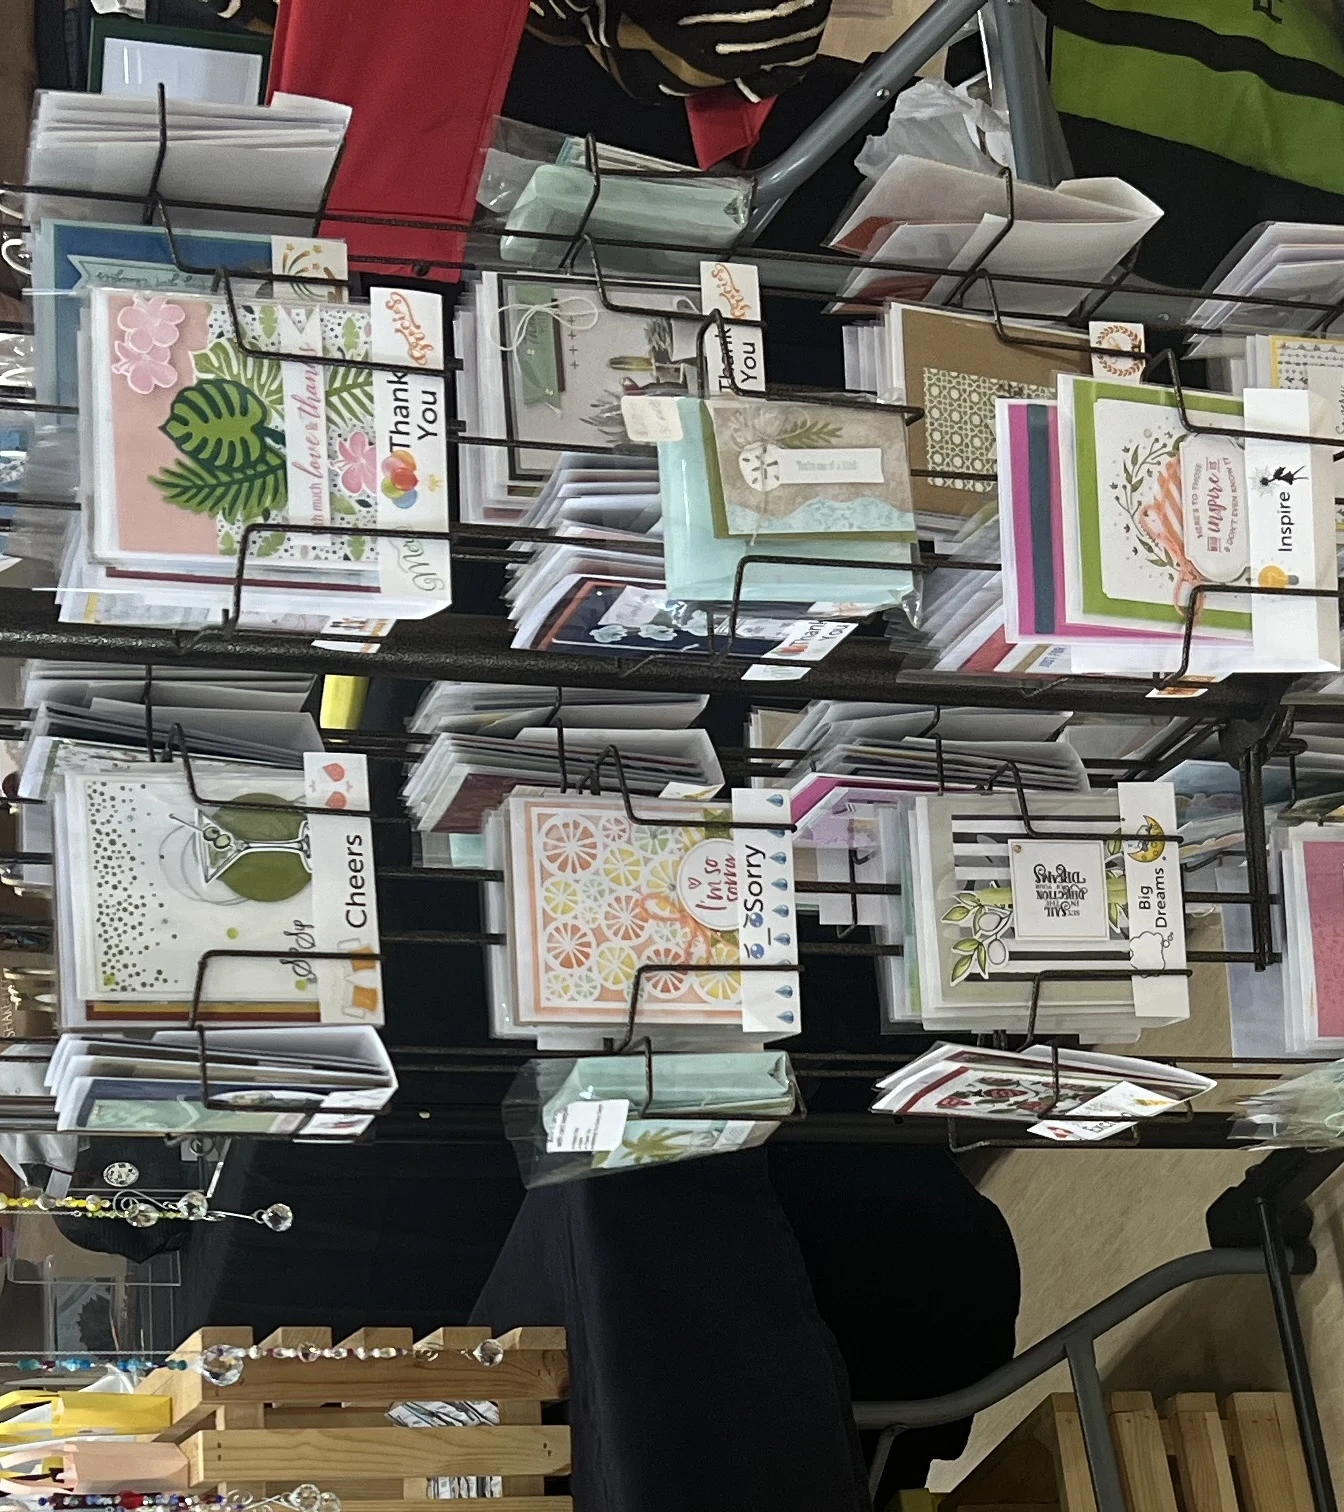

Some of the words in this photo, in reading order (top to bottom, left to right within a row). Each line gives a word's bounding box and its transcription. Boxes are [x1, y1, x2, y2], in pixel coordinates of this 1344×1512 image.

[740, 341, 758, 383] You
[387, 371, 411, 453] Thank
[417, 390, 438, 441] You
[291, 430, 324, 479] love
[308, 482, 323, 512] much
[1226, 467, 1236, 493] KNOW
[1191, 493, 1199, 505] TO
[1207, 473, 1227, 533] inspire
[1226, 519, 1236, 546] DON'T
[1275, 491, 1294, 553] Inspire
[345, 834, 368, 929] Cheers
[704, 856, 721, 875] so
[743, 844, 766, 912] Sorry
[1033, 863, 1086, 883] DREAMS
[695, 880, 727, 910] I'm
[1044, 900, 1070, 917] SAIL
[1138, 885, 1154, 910] Big
[1153, 867, 1168, 928] Dreams
